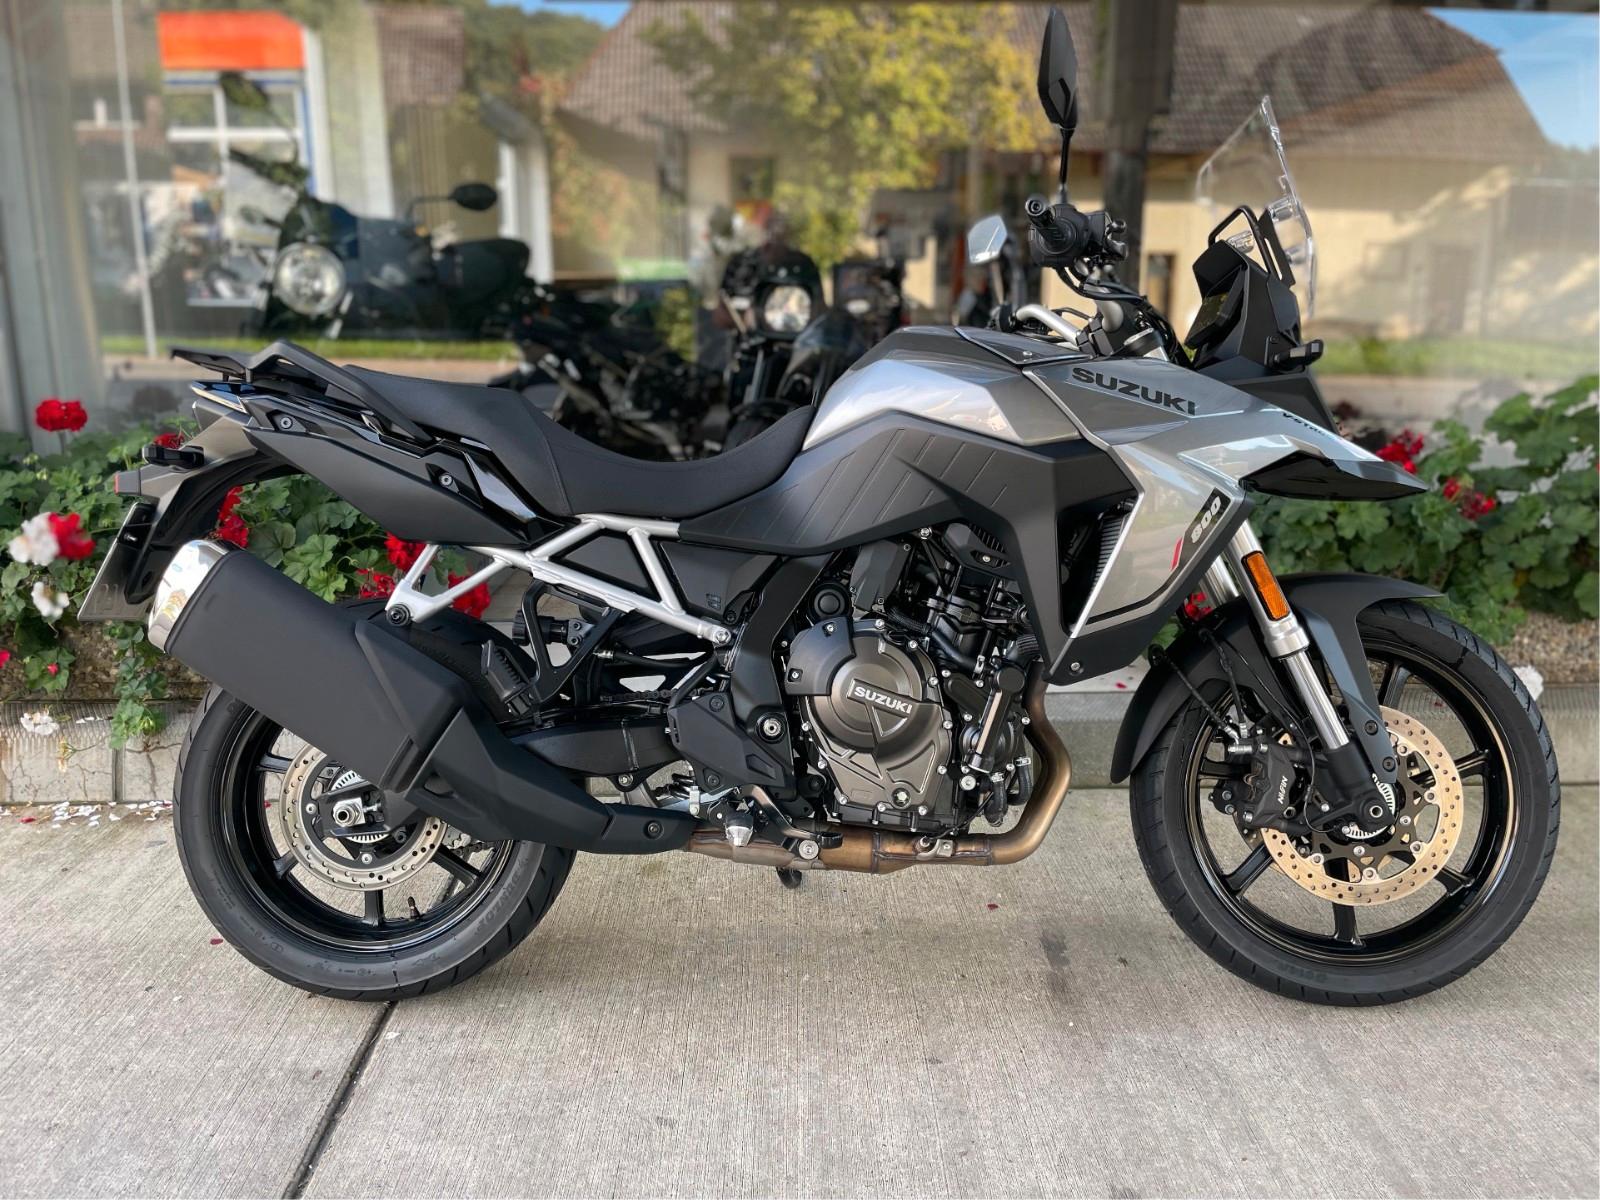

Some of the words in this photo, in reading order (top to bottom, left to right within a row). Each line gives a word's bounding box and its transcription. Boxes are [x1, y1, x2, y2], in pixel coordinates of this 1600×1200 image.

[1072, 367, 1196, 416] SUZUKI
[1190, 495, 1222, 544] 800
[854, 685, 913, 714] SUZUKI
